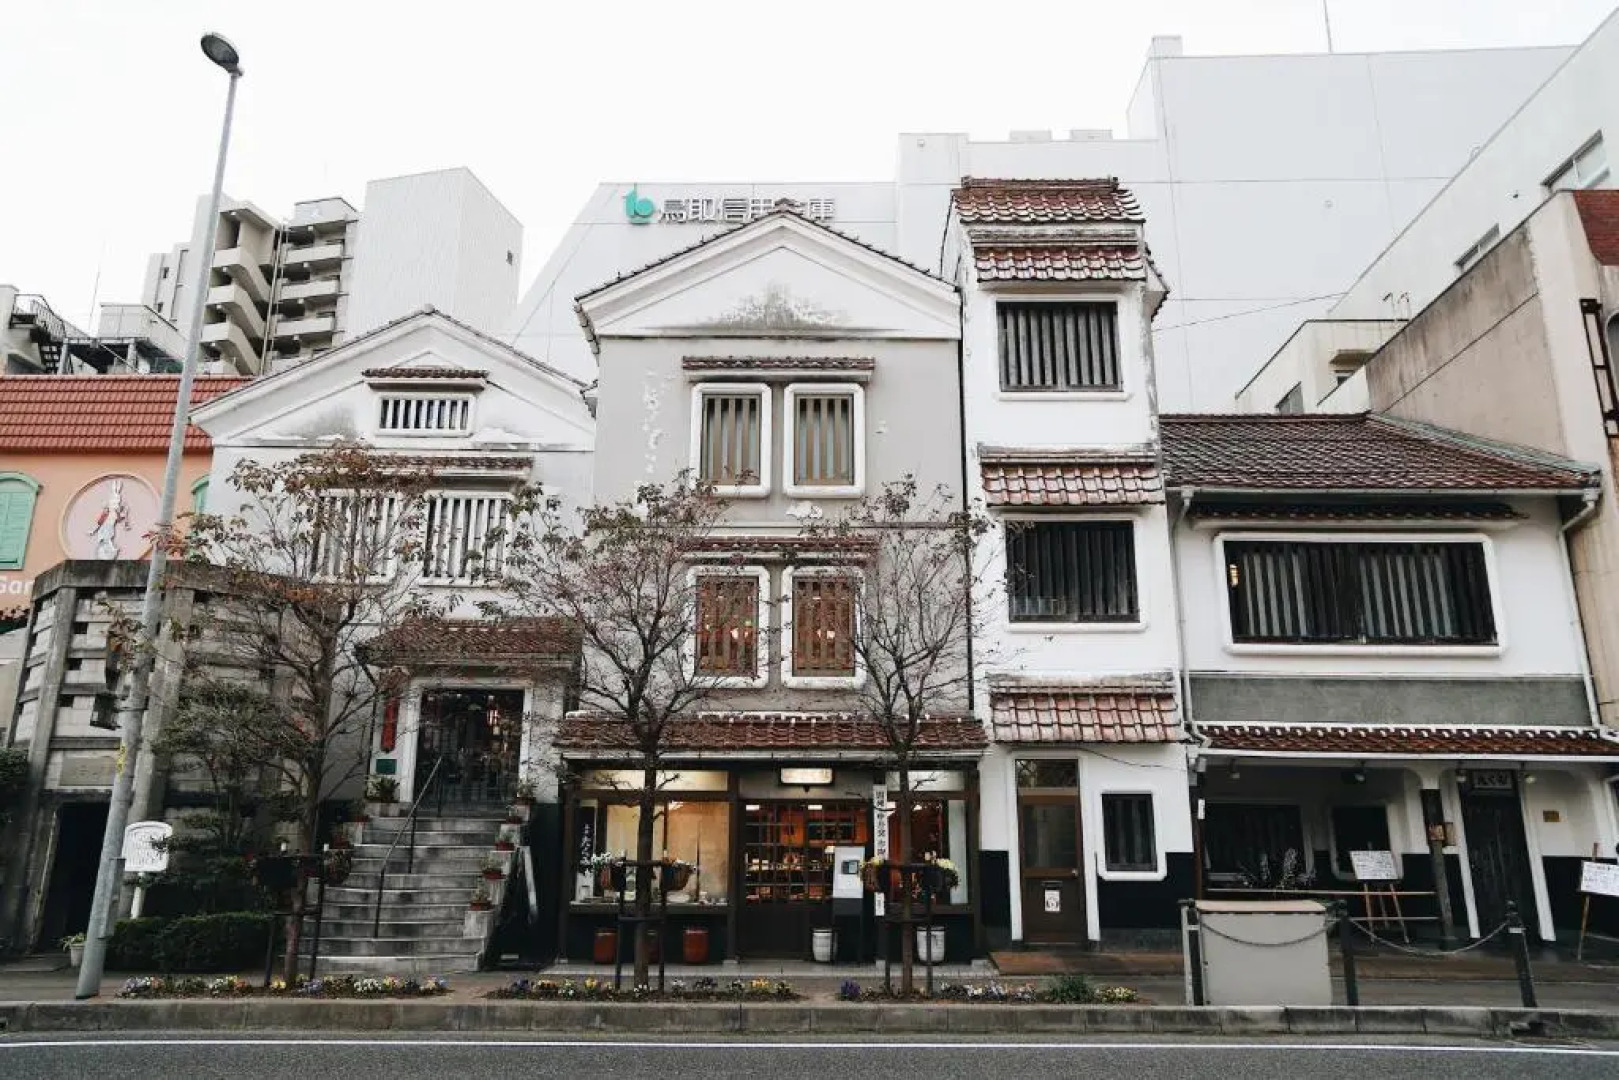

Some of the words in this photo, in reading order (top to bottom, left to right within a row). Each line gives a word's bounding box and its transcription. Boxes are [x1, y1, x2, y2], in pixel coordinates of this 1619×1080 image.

[659, 198, 835, 222] 鳥取信用庫
